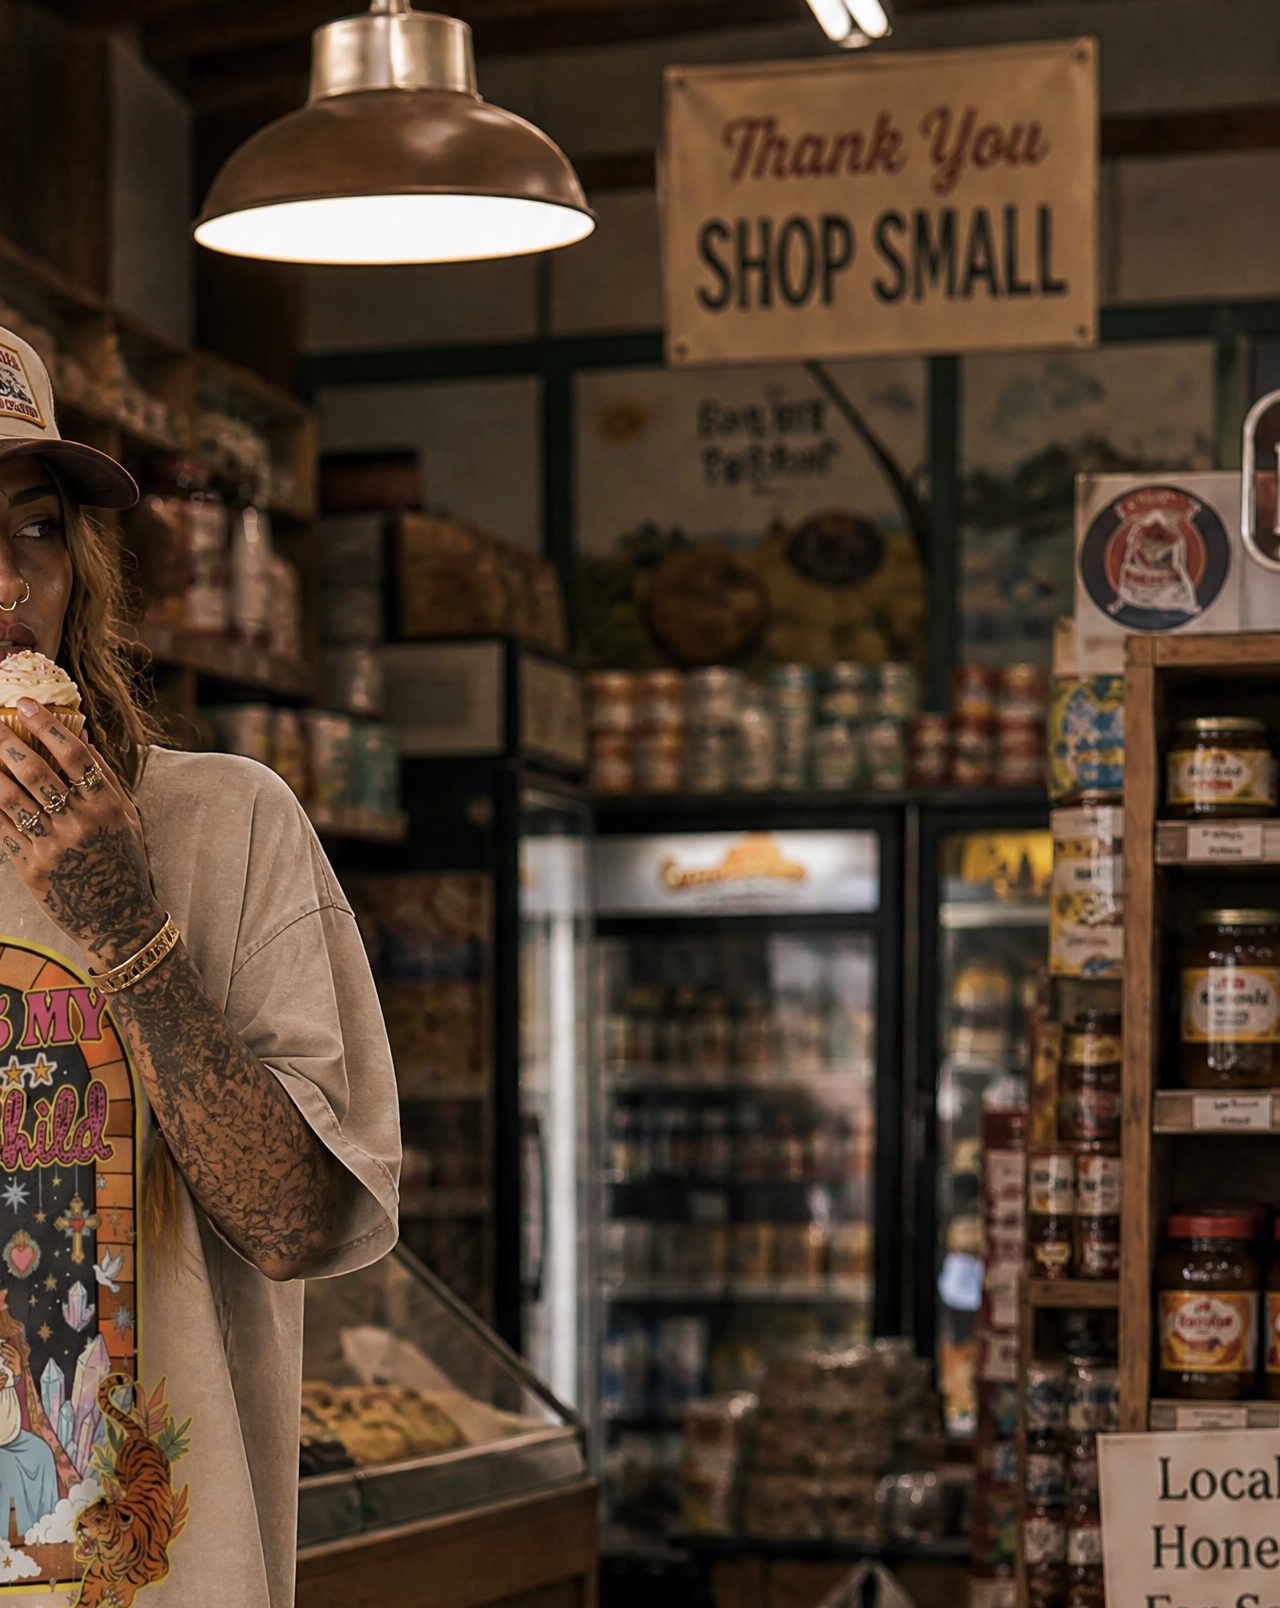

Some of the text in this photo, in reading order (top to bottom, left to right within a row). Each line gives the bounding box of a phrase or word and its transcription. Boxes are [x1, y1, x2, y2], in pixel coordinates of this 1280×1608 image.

[721, 103, 1051, 197] Thank You
[696, 203, 1068, 314] SHOP SMALL
[16, 985, 107, 1049] MY
